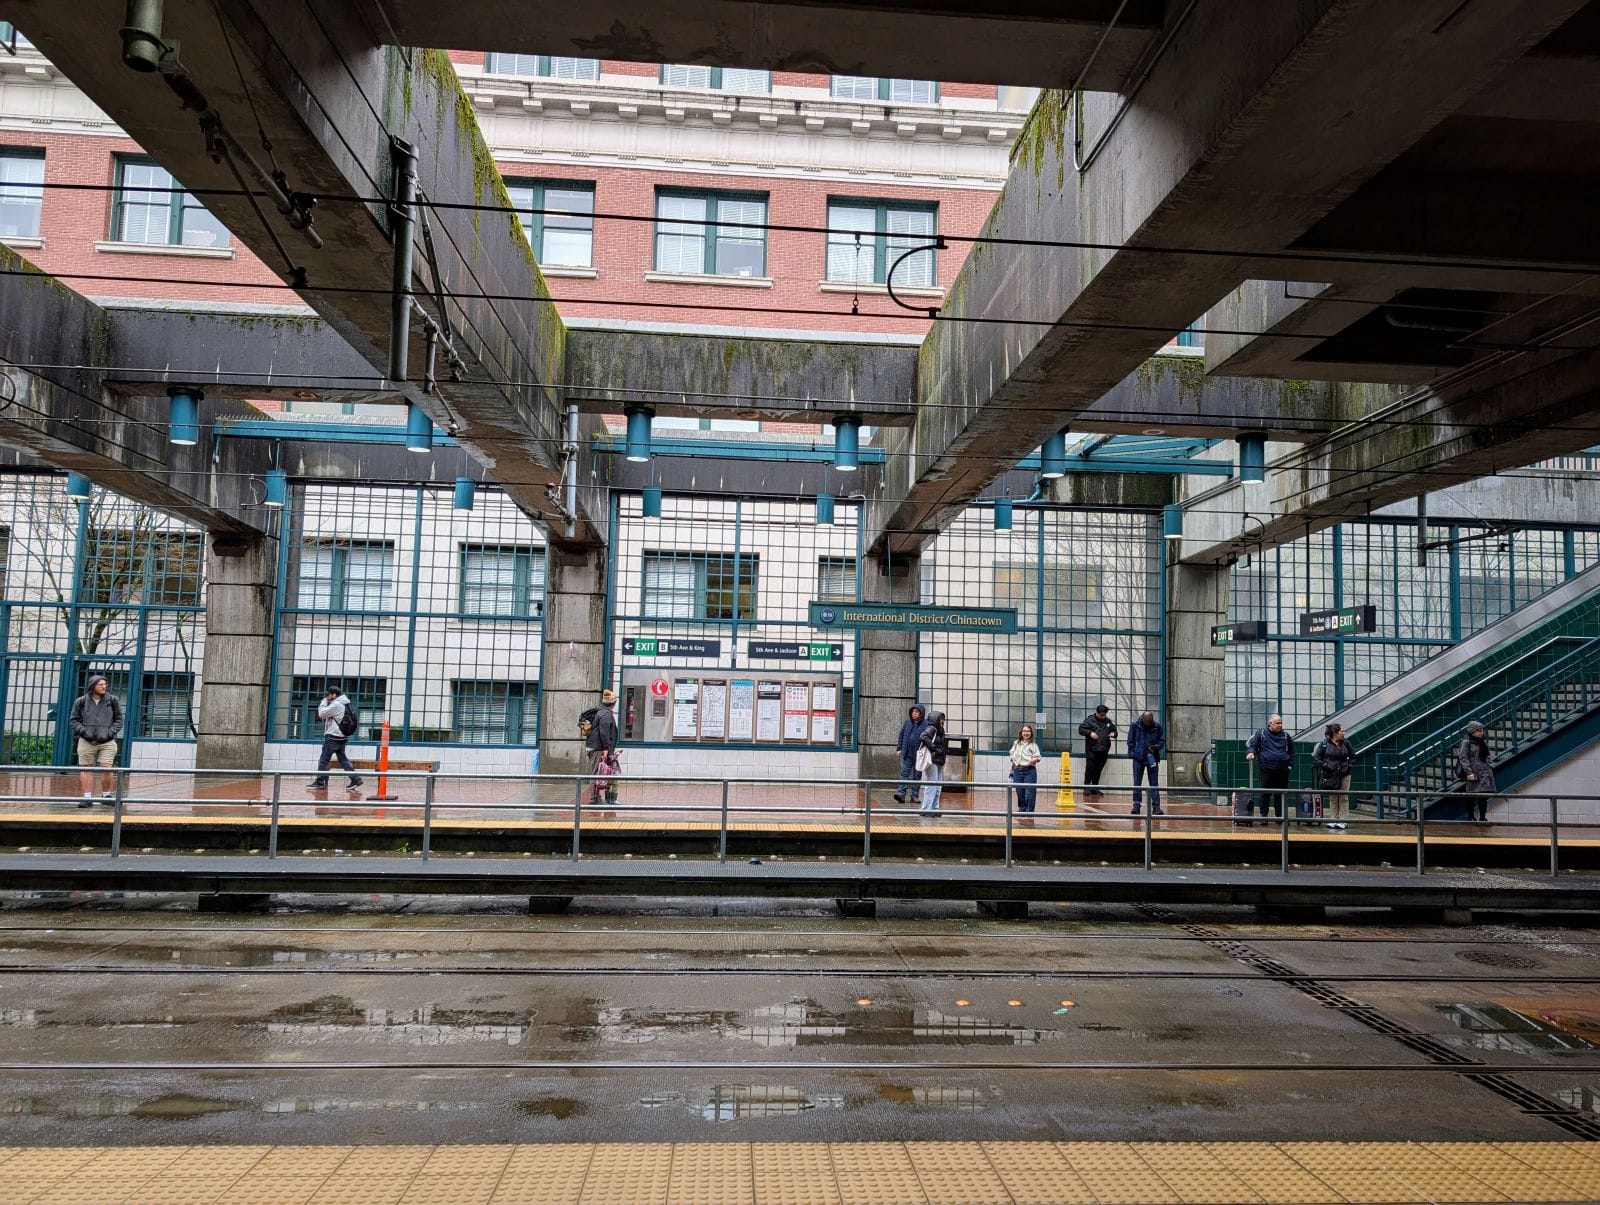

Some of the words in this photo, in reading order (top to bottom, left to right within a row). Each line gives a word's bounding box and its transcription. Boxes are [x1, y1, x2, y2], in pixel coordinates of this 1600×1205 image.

[843, 610, 906, 623] International
[909, 612, 1002, 626] District/Chinatown
[1339, 615, 1353, 627] EXIT
[1217, 631, 1227, 641] EXIT
[635, 642, 655, 651] EXIT
[800, 647, 806, 655] A
[811, 647, 830, 656] EXIT
